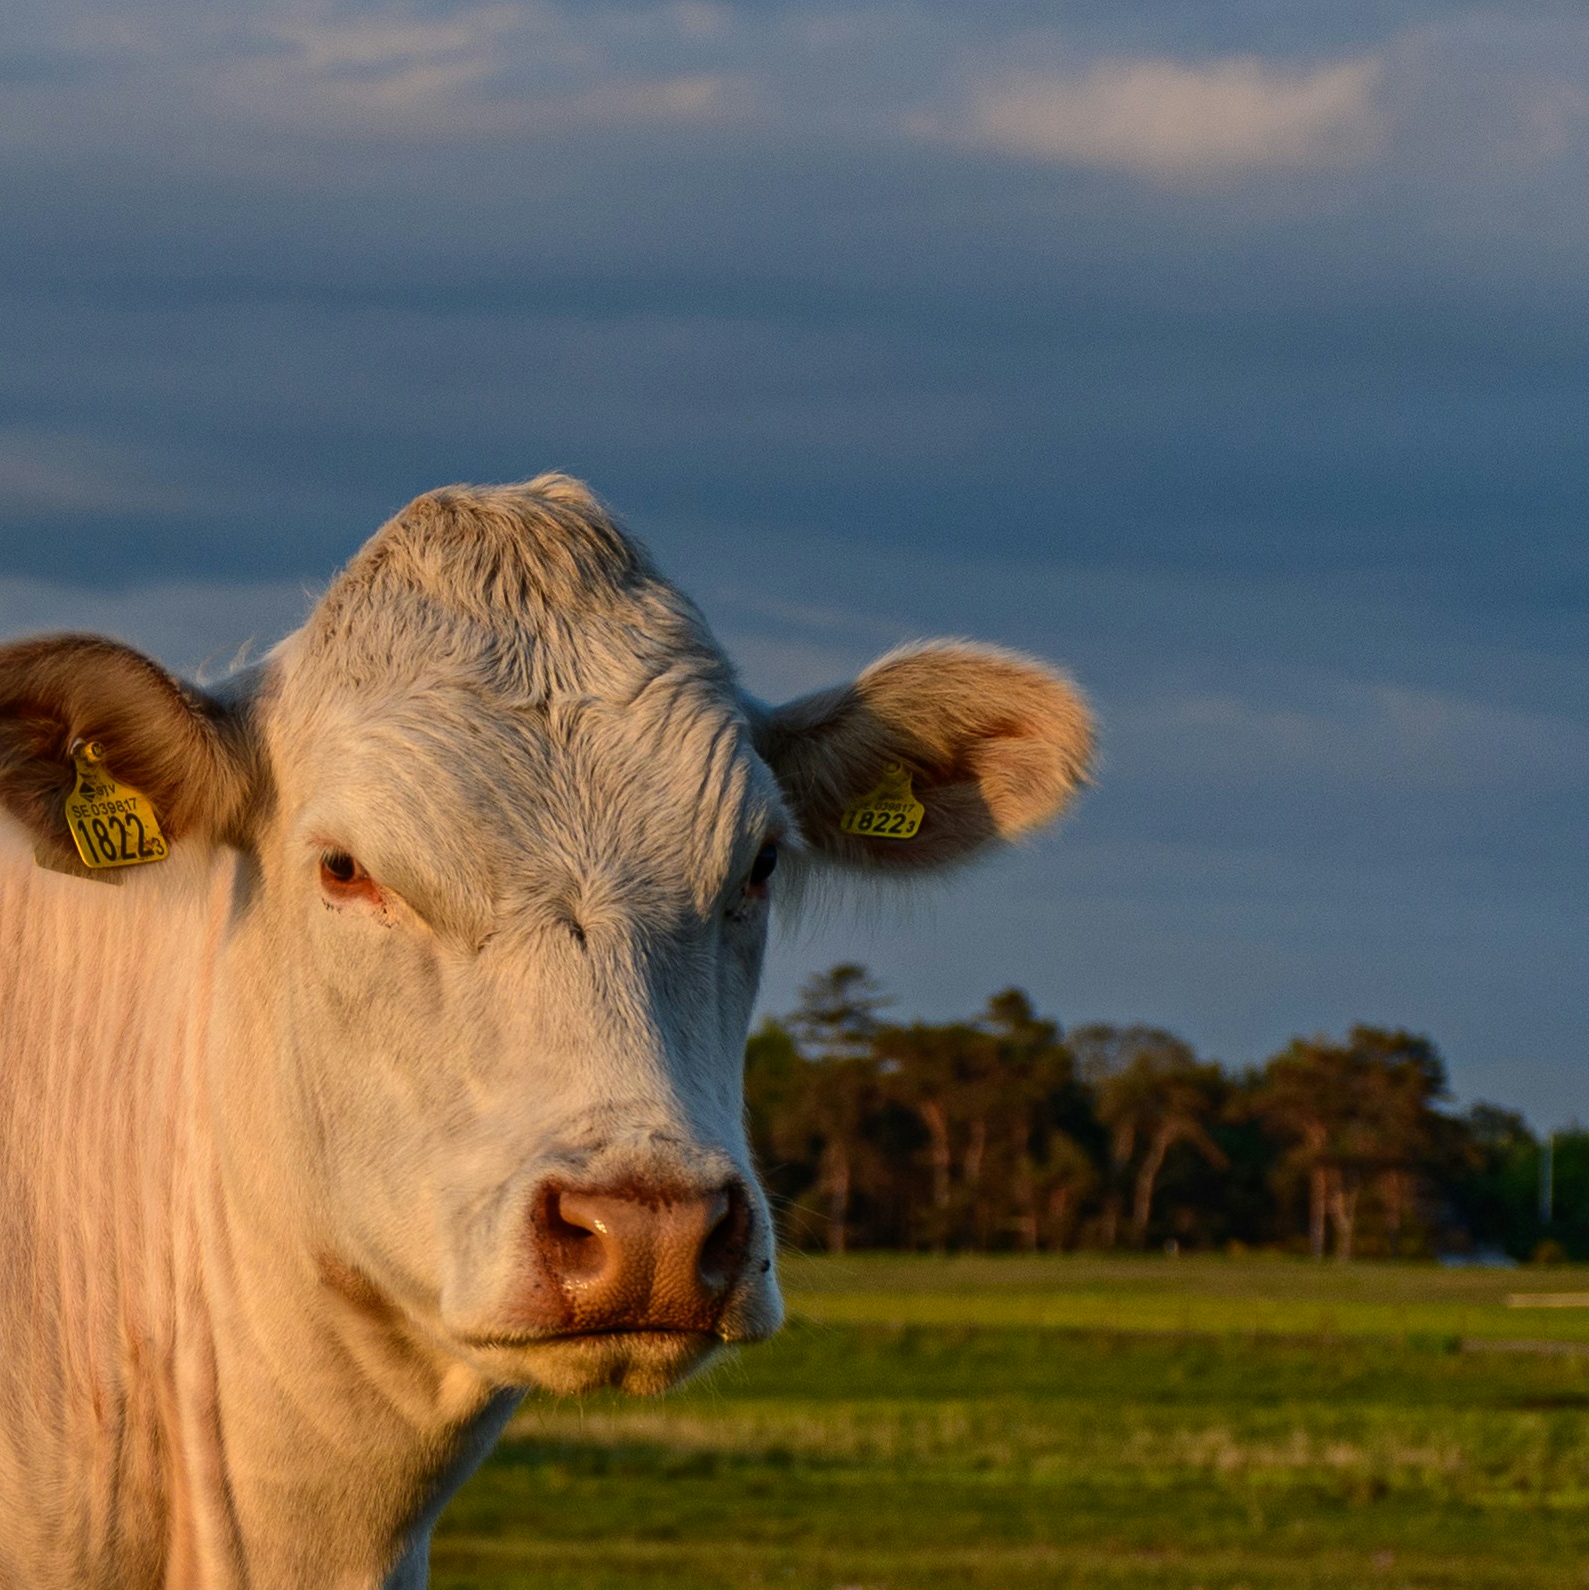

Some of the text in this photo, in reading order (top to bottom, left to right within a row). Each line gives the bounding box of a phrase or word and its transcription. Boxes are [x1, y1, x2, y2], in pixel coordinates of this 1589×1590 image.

[71, 797, 138, 819] SE 039817
[846, 811, 916, 833] 1822 3
[77, 813, 165, 863] 1822 3
